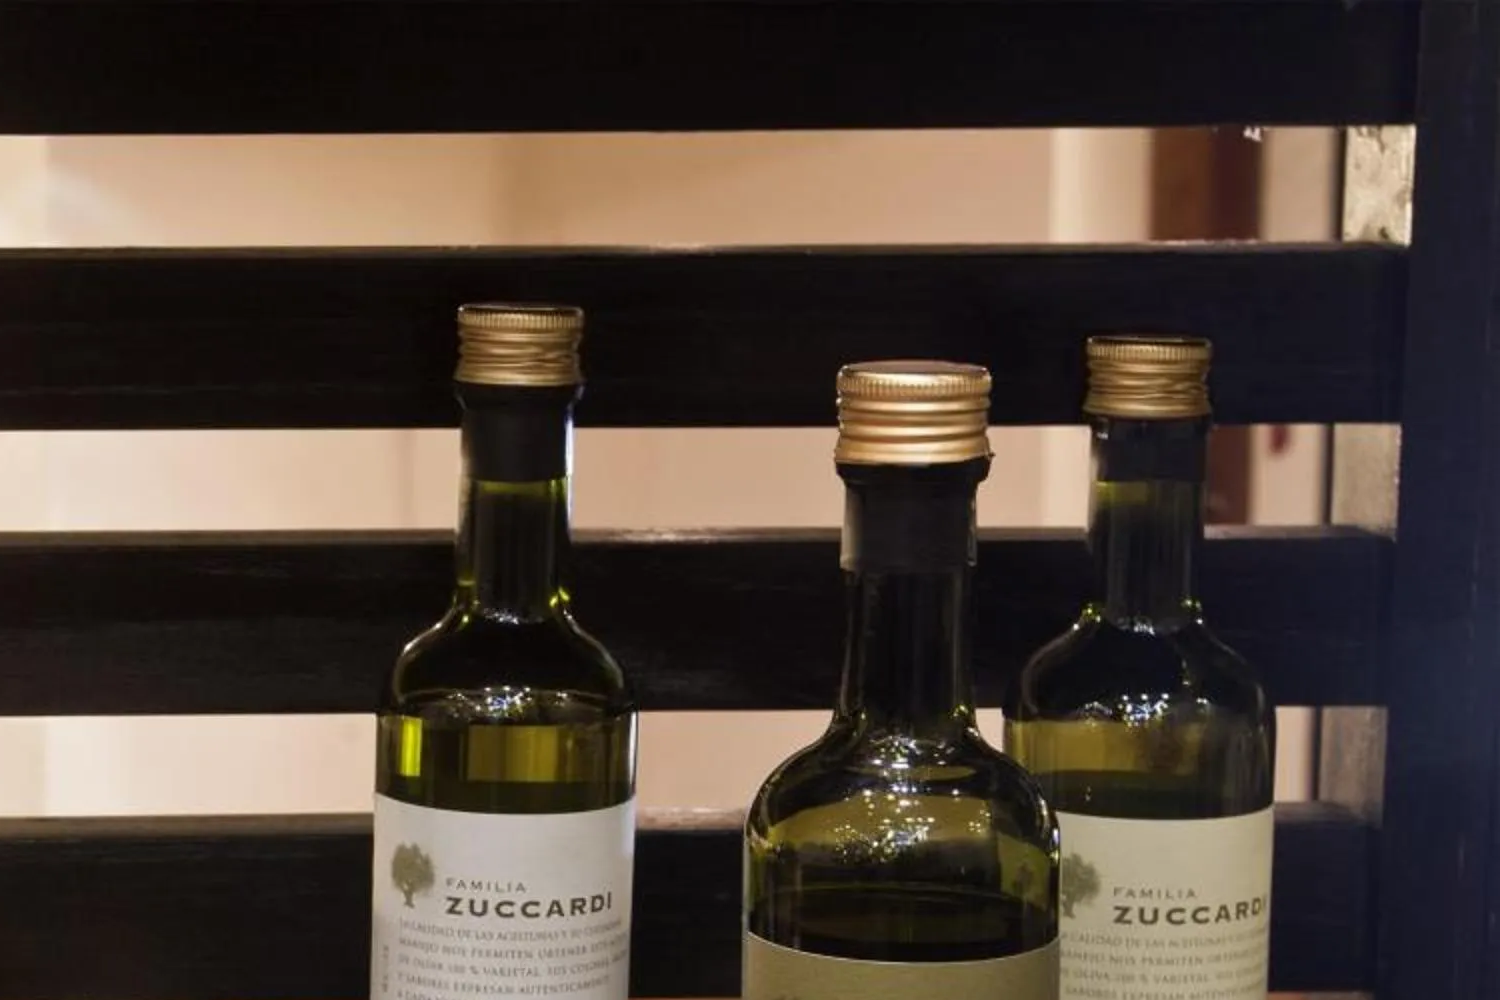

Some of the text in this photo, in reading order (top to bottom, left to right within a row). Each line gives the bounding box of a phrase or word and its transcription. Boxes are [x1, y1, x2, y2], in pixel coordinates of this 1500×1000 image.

[446, 877, 527, 893] FAMILIA
[1113, 886, 1198, 900] FAMILIA
[445, 891, 612, 919] ZUCCARDI
